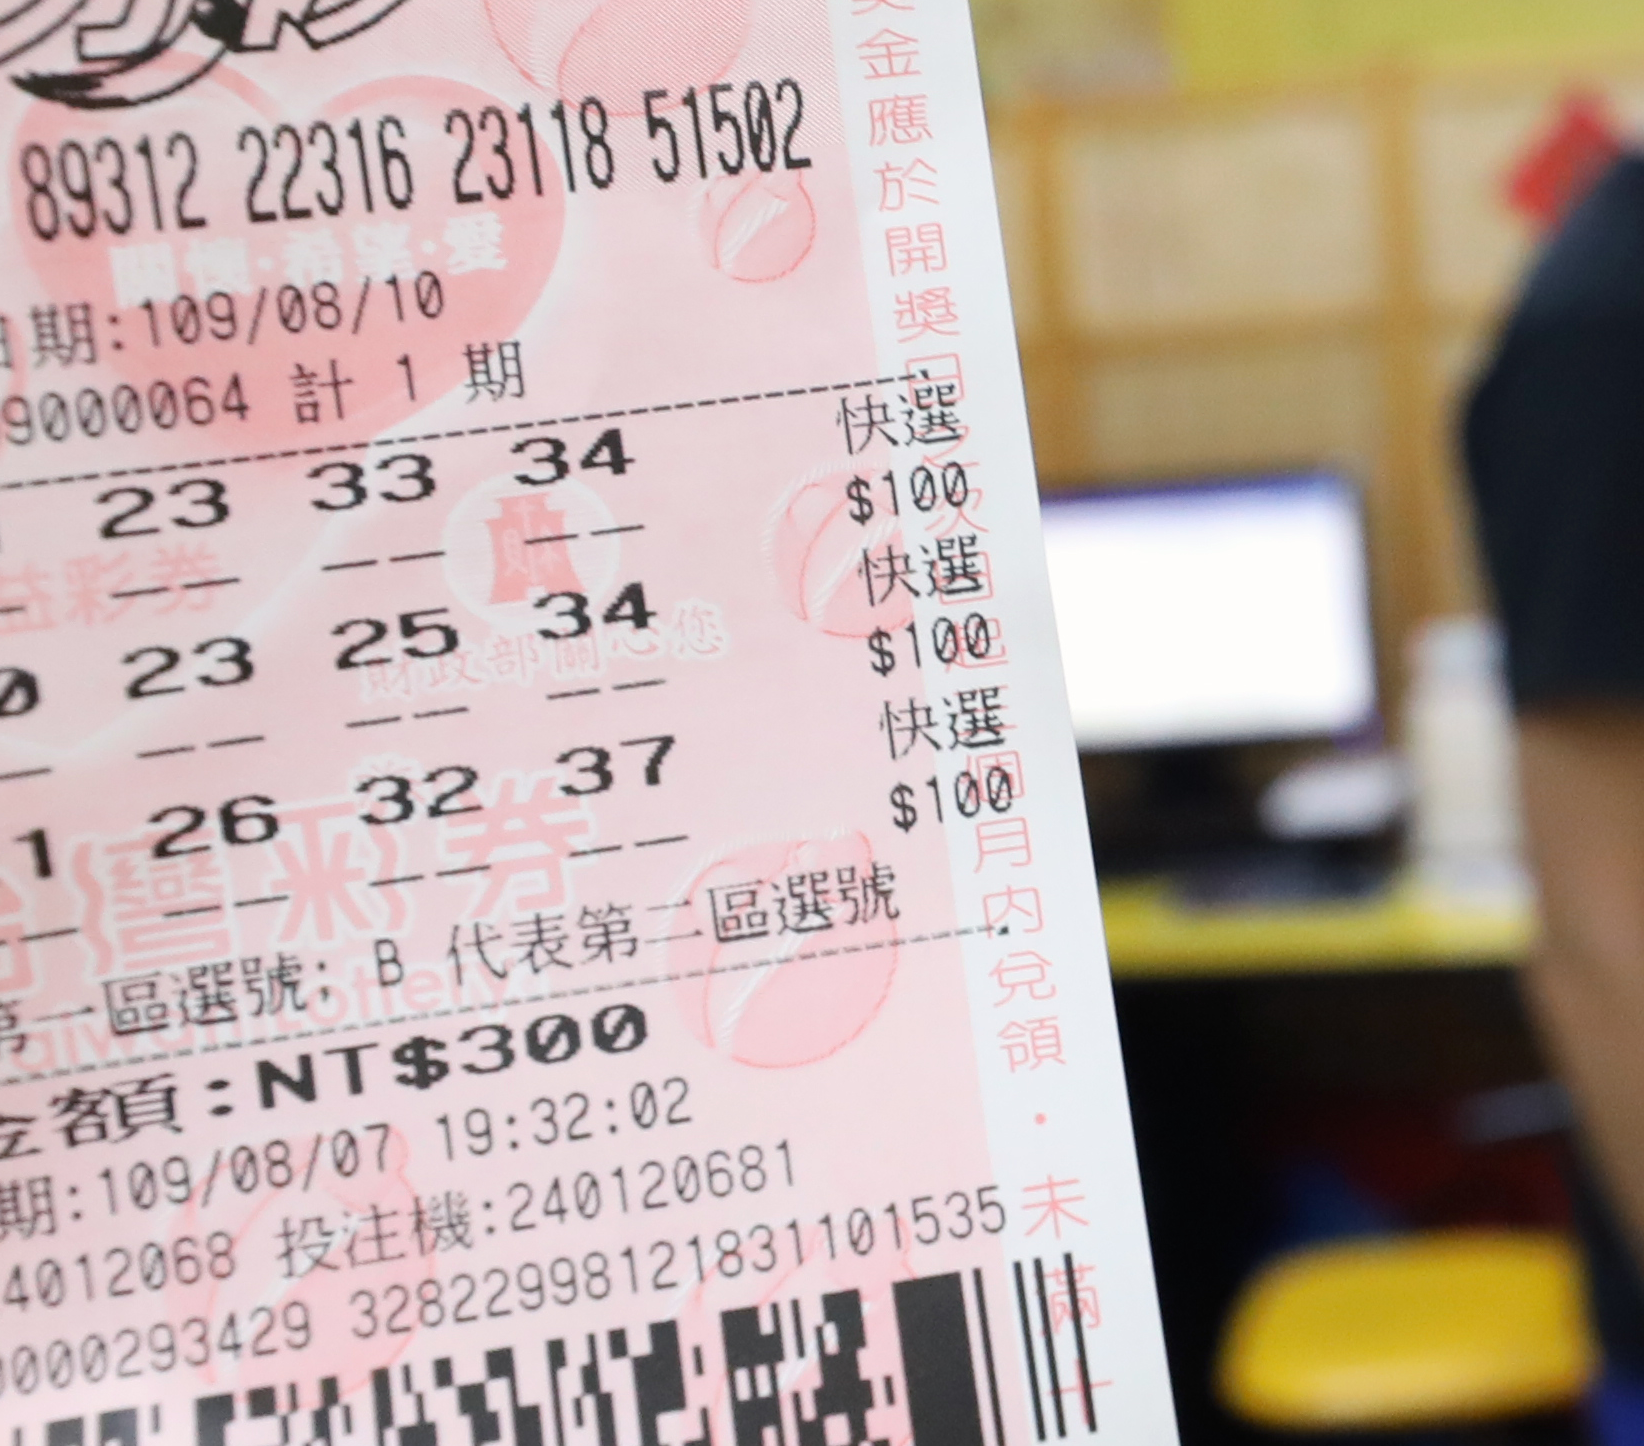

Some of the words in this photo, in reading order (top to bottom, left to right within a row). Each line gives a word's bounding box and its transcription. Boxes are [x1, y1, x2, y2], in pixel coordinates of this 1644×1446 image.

[20, 131, 207, 242] 89312
[238, 115, 415, 224] 22316
[445, 95, 616, 205] 23118
[645, 76, 813, 184] 51502
[289, 359, 356, 426] 計
[396, 355, 419, 403] 1
[463, 339, 527, 405] 期
[96, 477, 231, 541] 23
[306, 452, 437, 511] 33
[512, 427, 637, 486] 34
[836, 381, 964, 456] 快選
[846, 460, 970, 526] $100
[121, 636, 258, 700] 23
[330, 607, 461, 672] 25
[532, 581, 659, 642] 34
[857, 533, 985, 608] 快選
[867, 611, 994, 678] $100
[148, 793, 284, 861] 26
[355, 763, 485, 827] 32
[555, 734, 679, 798] 37
[877, 686, 1009, 761] 快選
[890, 763, 1017, 836] $100
[373, 937, 407, 992] B
[447, 861, 902, 986] 代表第二區選號
[437, 1076, 694, 1161] 19:32:02
[276, 1139, 797, 1282] 投注機:240120681
[350, 1184, 1008, 1341] 32822998121831101535
